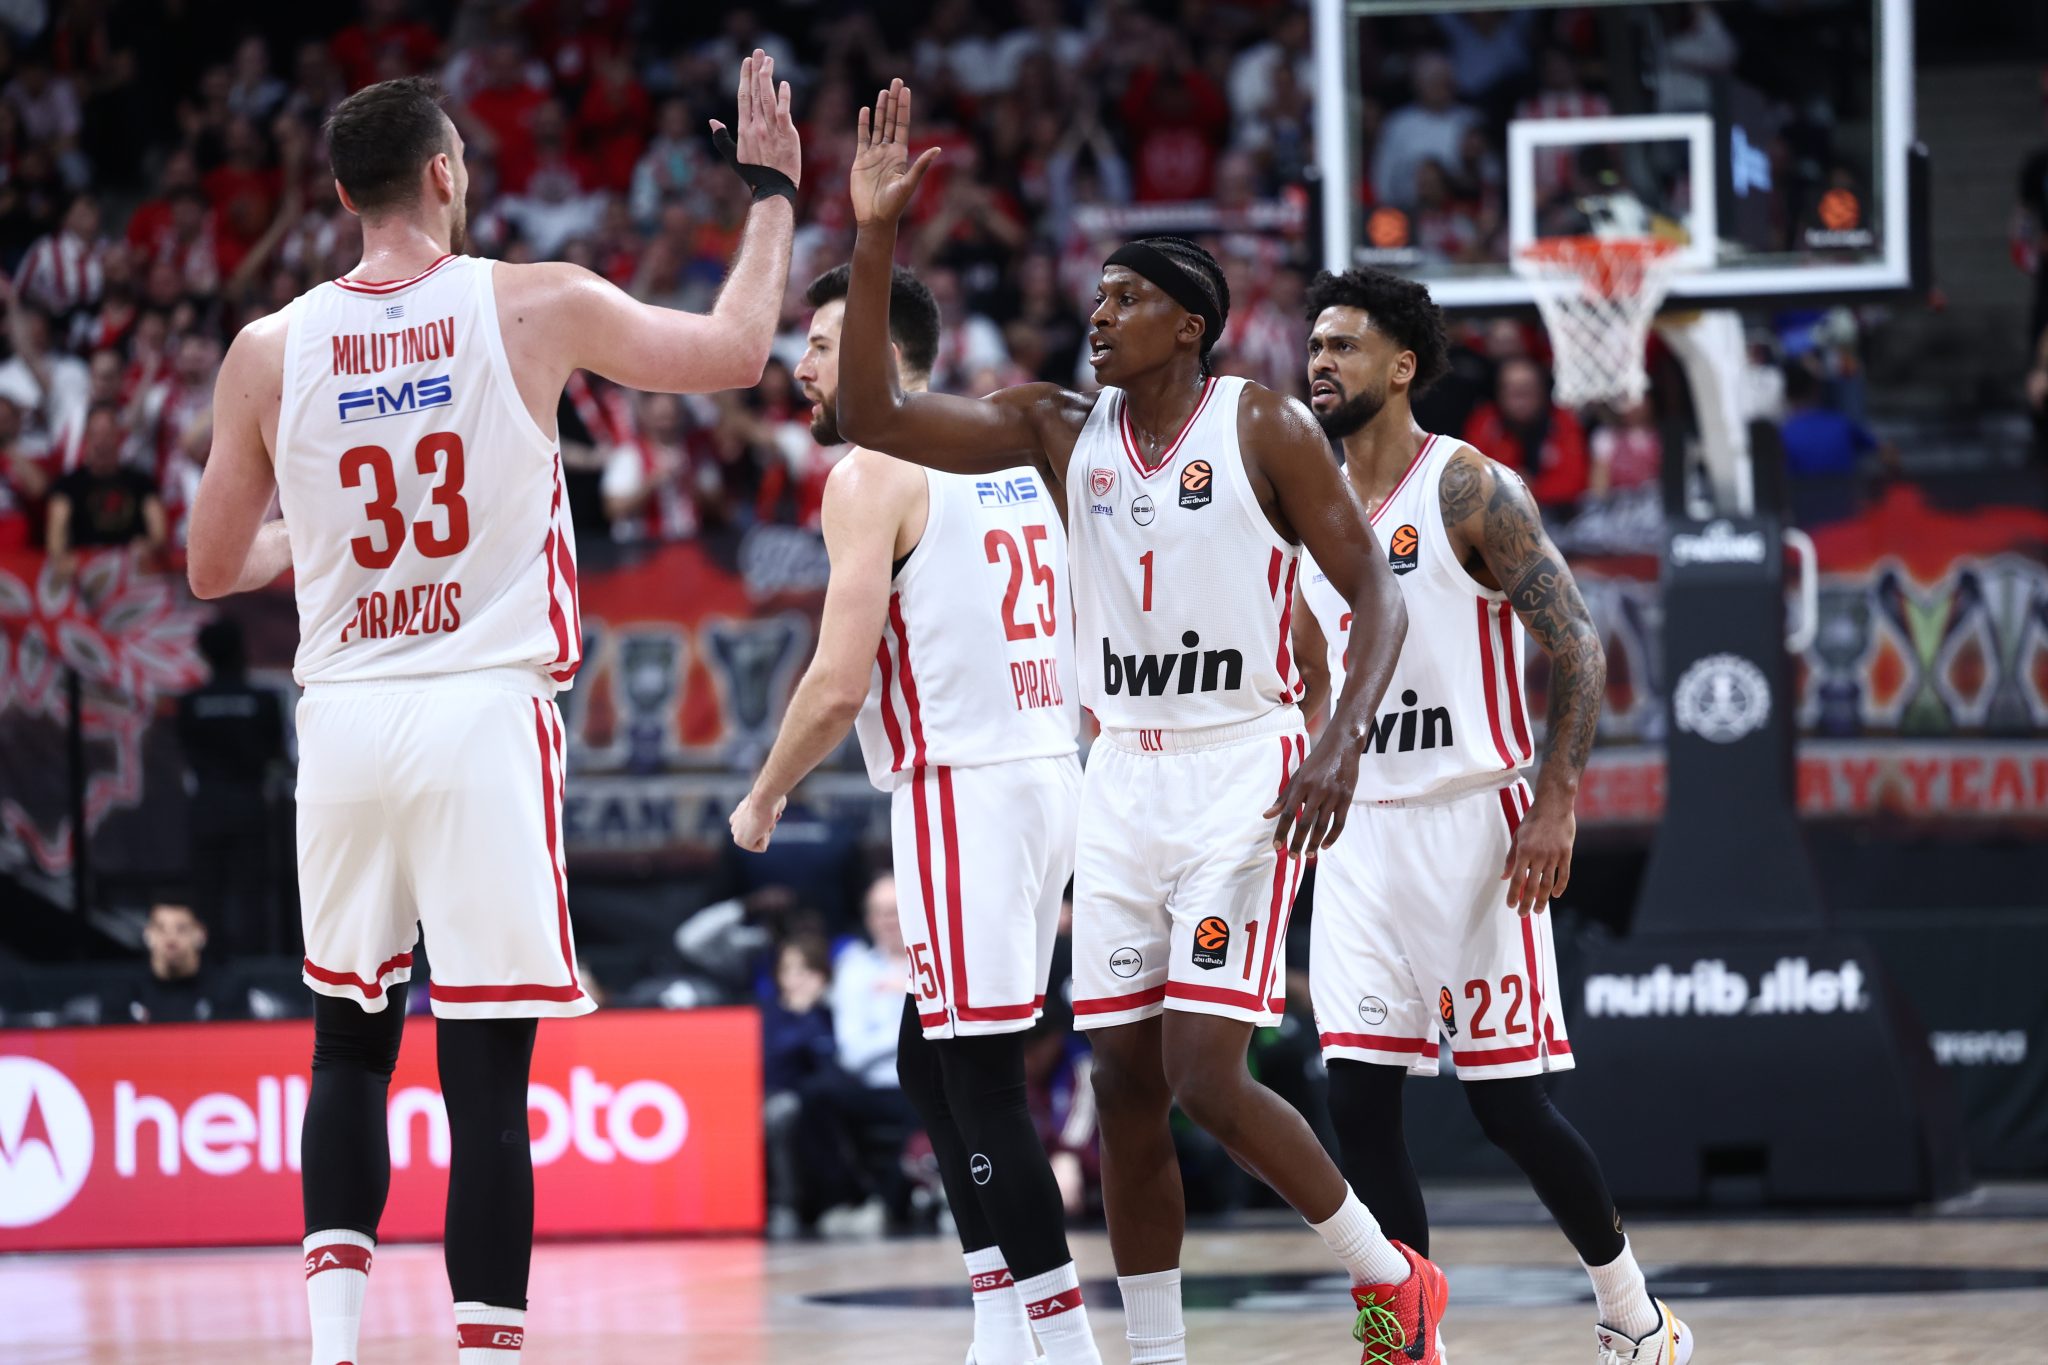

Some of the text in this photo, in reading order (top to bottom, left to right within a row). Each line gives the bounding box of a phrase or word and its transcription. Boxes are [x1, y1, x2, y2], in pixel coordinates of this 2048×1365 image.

[332, 316, 455, 376] MILUTINOV
[337, 374, 453, 421] FMS
[339, 431, 470, 570] 33
[975, 476, 1038, 505] FMS
[984, 525, 1056, 642] 25
[1139, 550, 1153, 612] 1
[341, 581, 462, 643] PIRAEUS
[1102, 630, 1243, 697] bwin
[1361, 689, 1453, 754] win
[1112, 958, 1140, 967] GSA
[1242, 920, 1258, 980] 1
[1361, 1005, 1385, 1015] GSA
[1464, 974, 1527, 1039] 22
[113, 1075, 307, 1177] hell
[305, 1251, 340, 1274] SA
[972, 1273, 1014, 1289] GSA
[492, 1331, 522, 1347] GS
